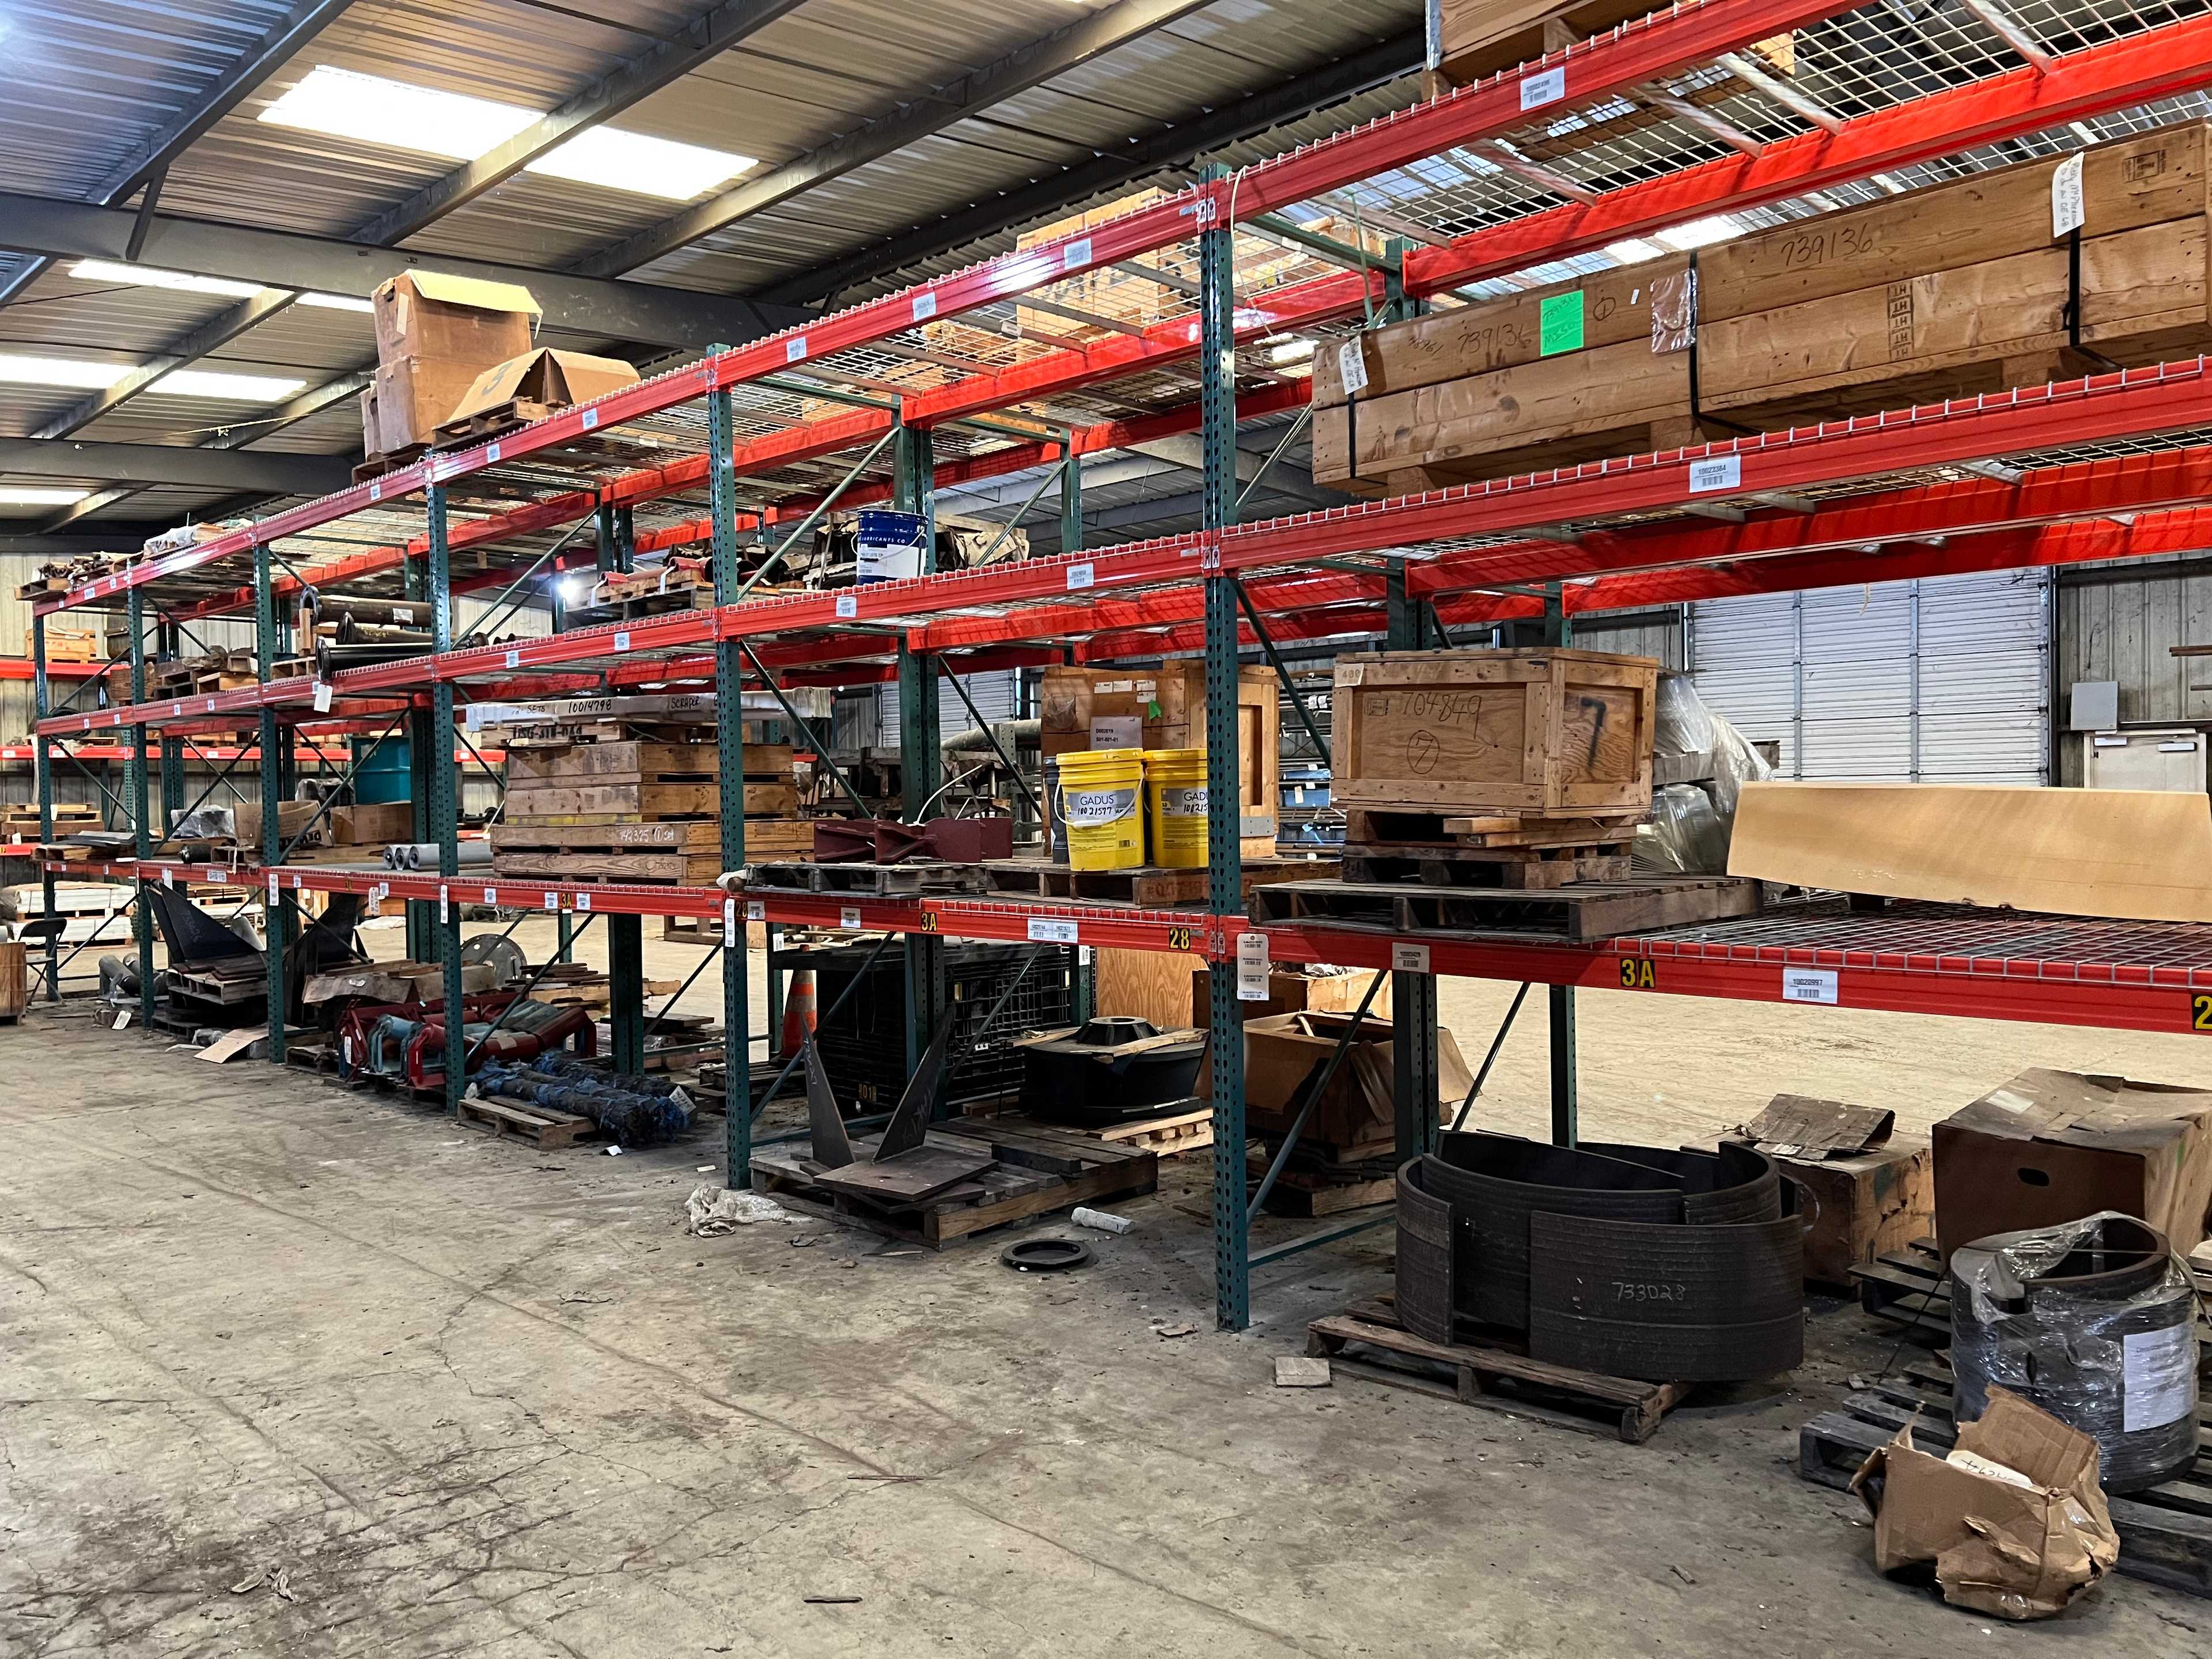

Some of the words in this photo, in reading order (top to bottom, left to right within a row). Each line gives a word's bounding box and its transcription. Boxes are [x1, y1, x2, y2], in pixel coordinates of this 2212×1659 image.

[1781, 222, 1873, 266] 739136
[1457, 324, 1532, 354] 739136
[568, 699, 612, 714] 10014798
[1402, 691, 1482, 739] 704849
[1581, 696, 1607, 770] 7
[1080, 794, 1115, 805] GADUS
[1184, 791, 1208, 802] GAD
[1078, 806, 1112, 816] 10021577
[1183, 803, 1208, 813] 100215
[562, 893, 571, 908] 3A
[736, 902, 748, 918] 28
[921, 912, 937, 931] 3A
[1169, 927, 1190, 950] 28
[1622, 959, 1654, 987] 3A
